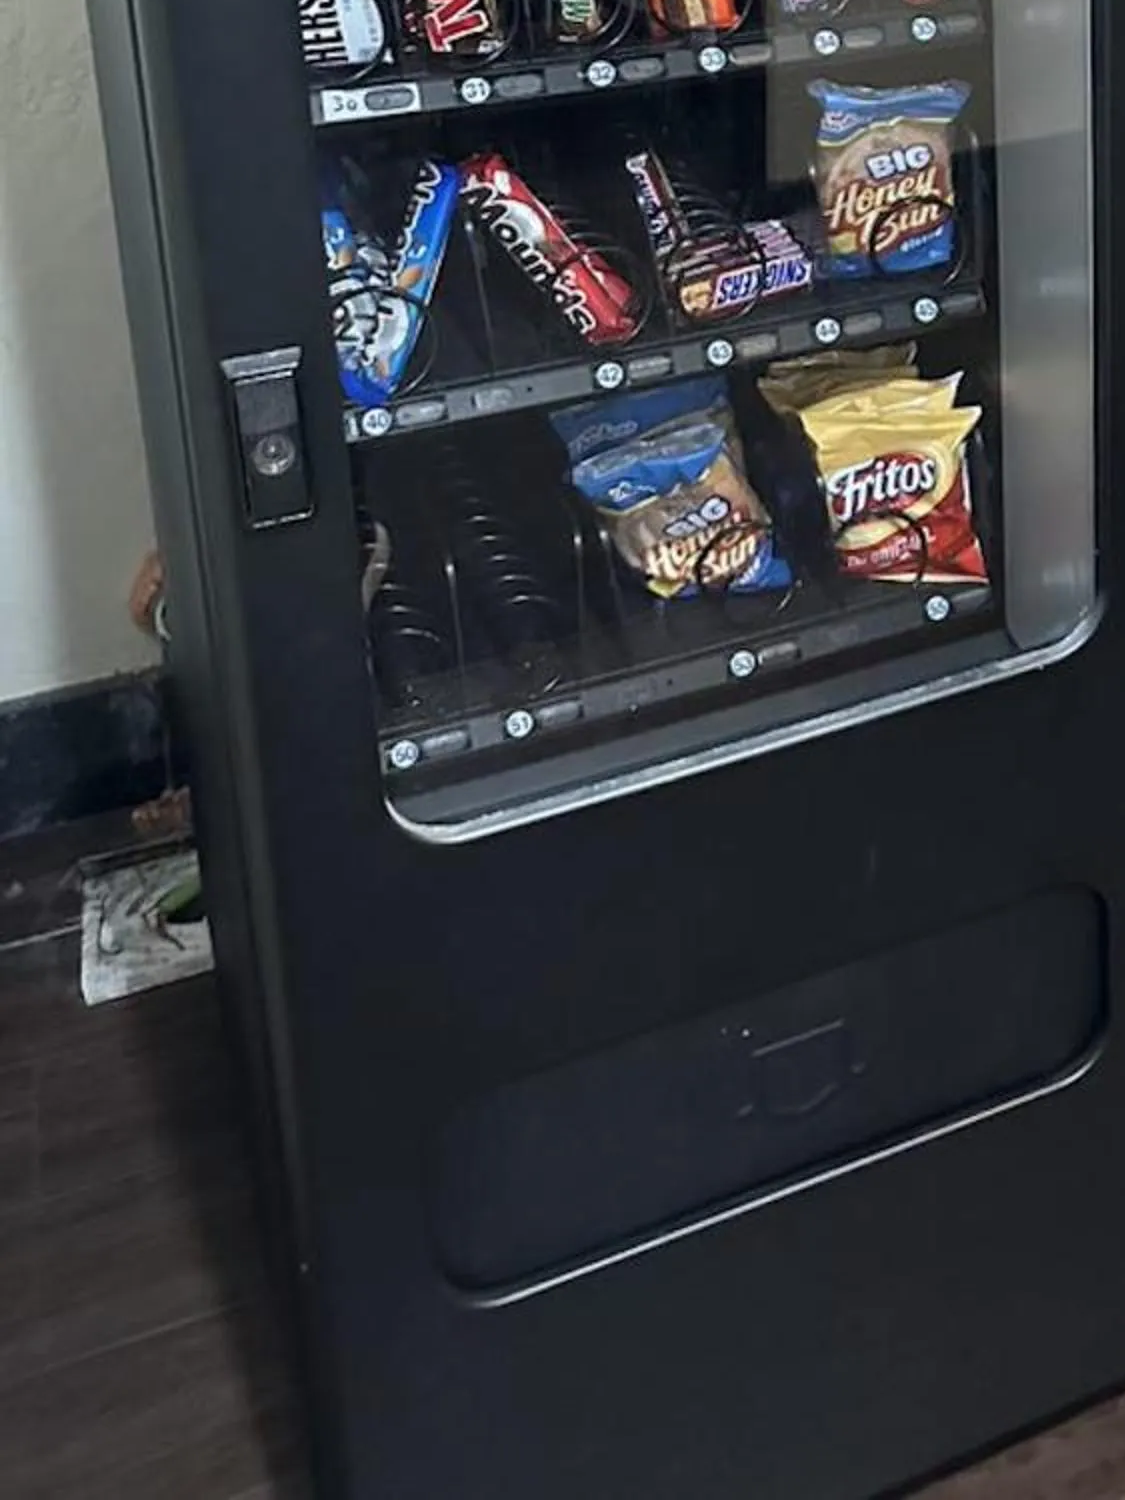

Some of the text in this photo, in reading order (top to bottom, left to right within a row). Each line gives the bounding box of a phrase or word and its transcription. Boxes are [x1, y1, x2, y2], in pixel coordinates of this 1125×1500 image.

[866, 145, 933, 180] BIG
[824, 166, 941, 231] Honey
[827, 457, 936, 522] Fritos
